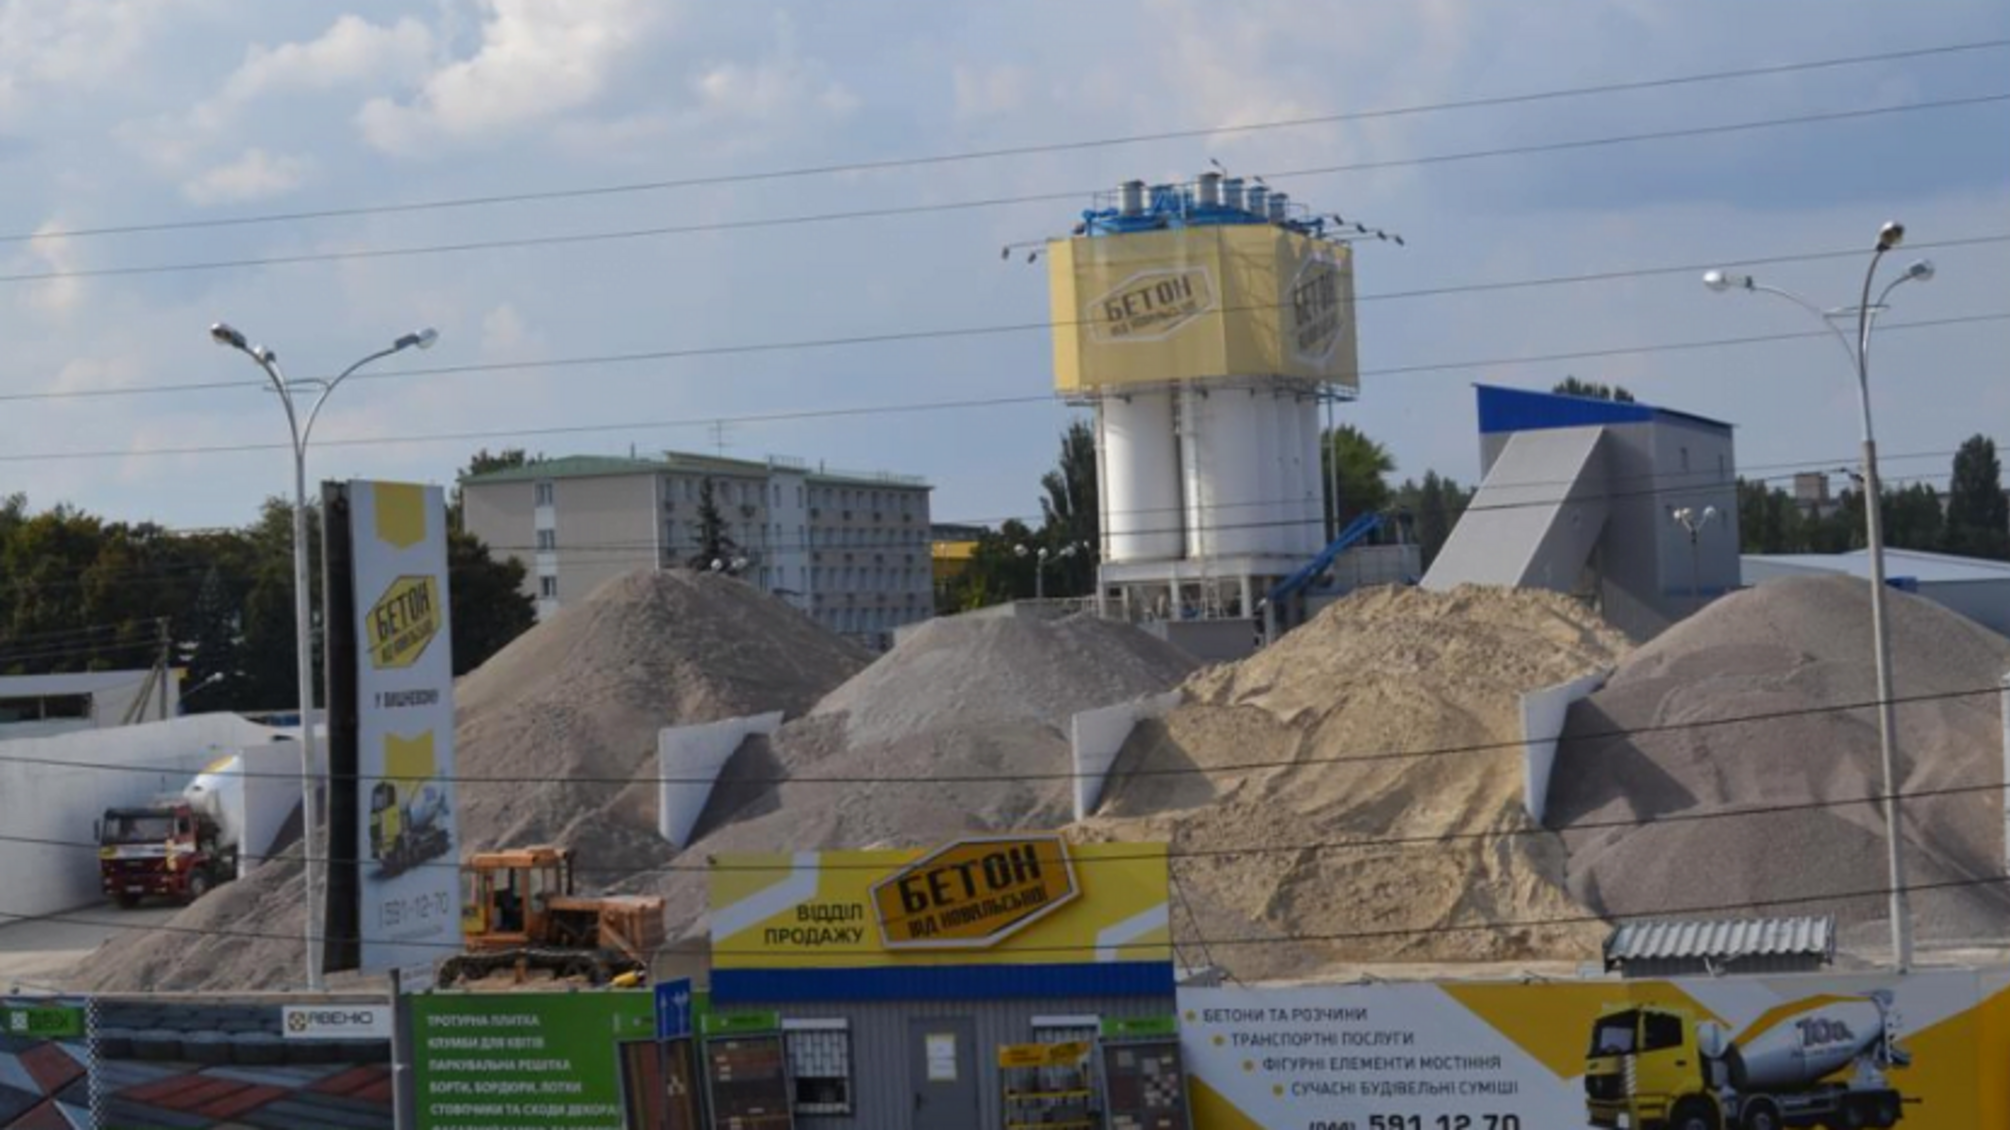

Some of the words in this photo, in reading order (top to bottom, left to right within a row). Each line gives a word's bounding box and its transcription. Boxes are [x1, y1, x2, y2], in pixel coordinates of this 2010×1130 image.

[1105, 274, 1192, 321] БЕТОН
[375, 580, 430, 642] БЕТОН
[898, 844, 1042, 913] БЕТОН
[797, 903, 864, 923] ВІДДІЛ
[764, 927, 864, 947] ПРОДАЖУ
[491, 1015, 541, 1027] ПЛИТКА
[1203, 1008, 1264, 1023] БЕТОНИ
[1269, 1008, 1288, 1022] ТА
[1292, 1007, 1368, 1022] РОЗЧИНИ
[480, 1037, 504, 1051] ДЛЯ
[1231, 1032, 1338, 1047] ТРАНСПОРТНІ
[1342, 1031, 1414, 1046] ПОСЛУГИ
[1262, 1056, 1326, 1071] ФІГУРНІ
[1330, 1056, 1415, 1071] ЕЛЕМЕНТИ
[1420, 1056, 1501, 1070] МОСТІННЯ
[1291, 1081, 1356, 1096] СУЧАСНІ
[1360, 1081, 1455, 1097] БУДІВЕЛЬНІ
[1459, 1080, 1518, 1095] СУМІШІ
[505, 1103, 521, 1117] ТА
[567, 1103, 620, 1117] ДЕКОРА
[1369, 1114, 1421, 1130] 591
[1436, 1114, 1471, 1130] 12
[1482, 1113, 1520, 1130] 70
